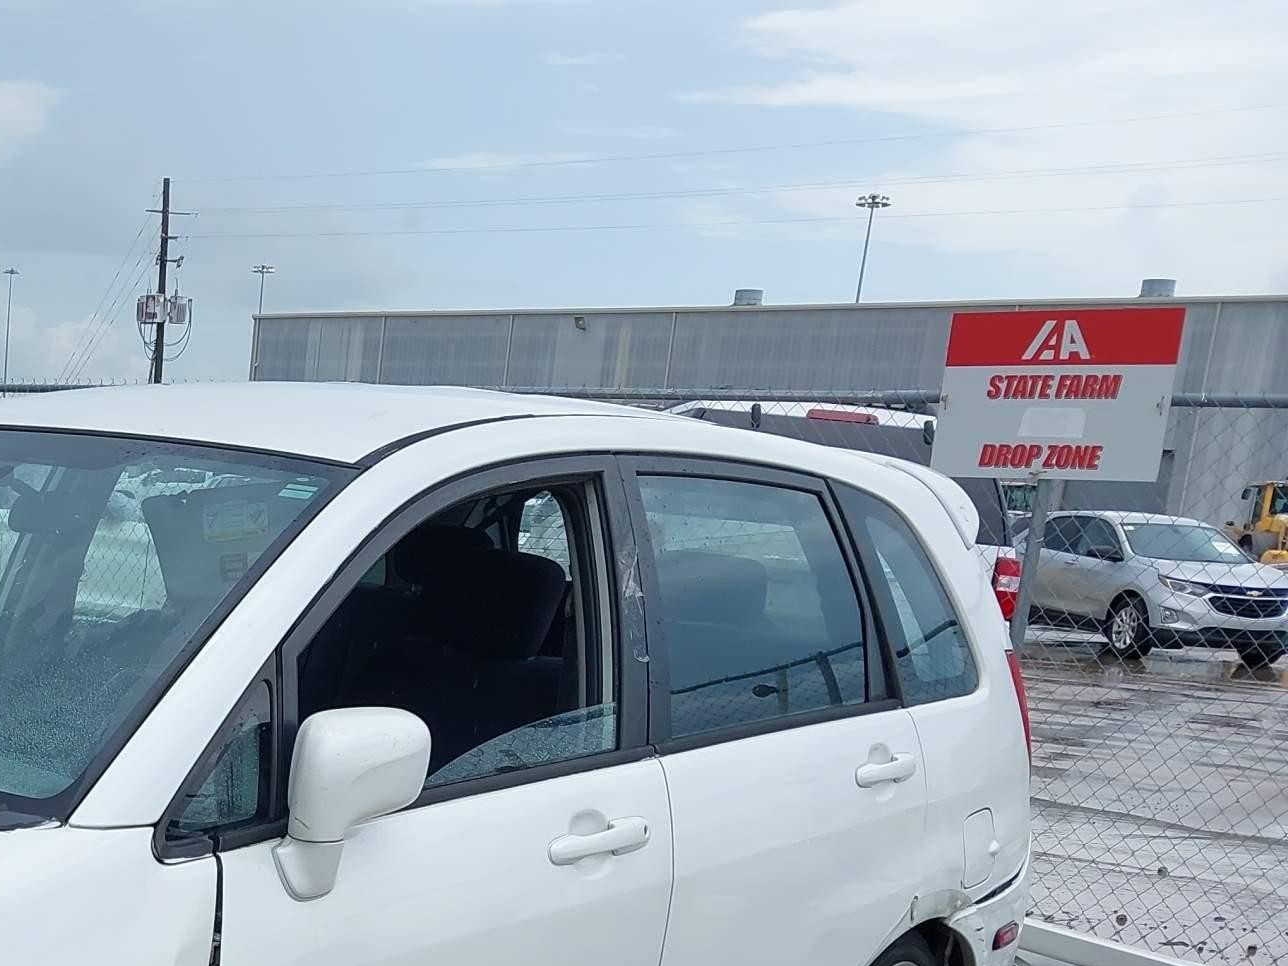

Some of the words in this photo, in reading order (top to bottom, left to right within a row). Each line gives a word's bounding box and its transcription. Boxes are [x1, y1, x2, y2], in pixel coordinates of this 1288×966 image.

[986, 374, 1055, 400] STATE
[1054, 374, 1123, 400] FARM
[978, 443, 1044, 469] DROP
[1042, 444, 1103, 470] ZONE
